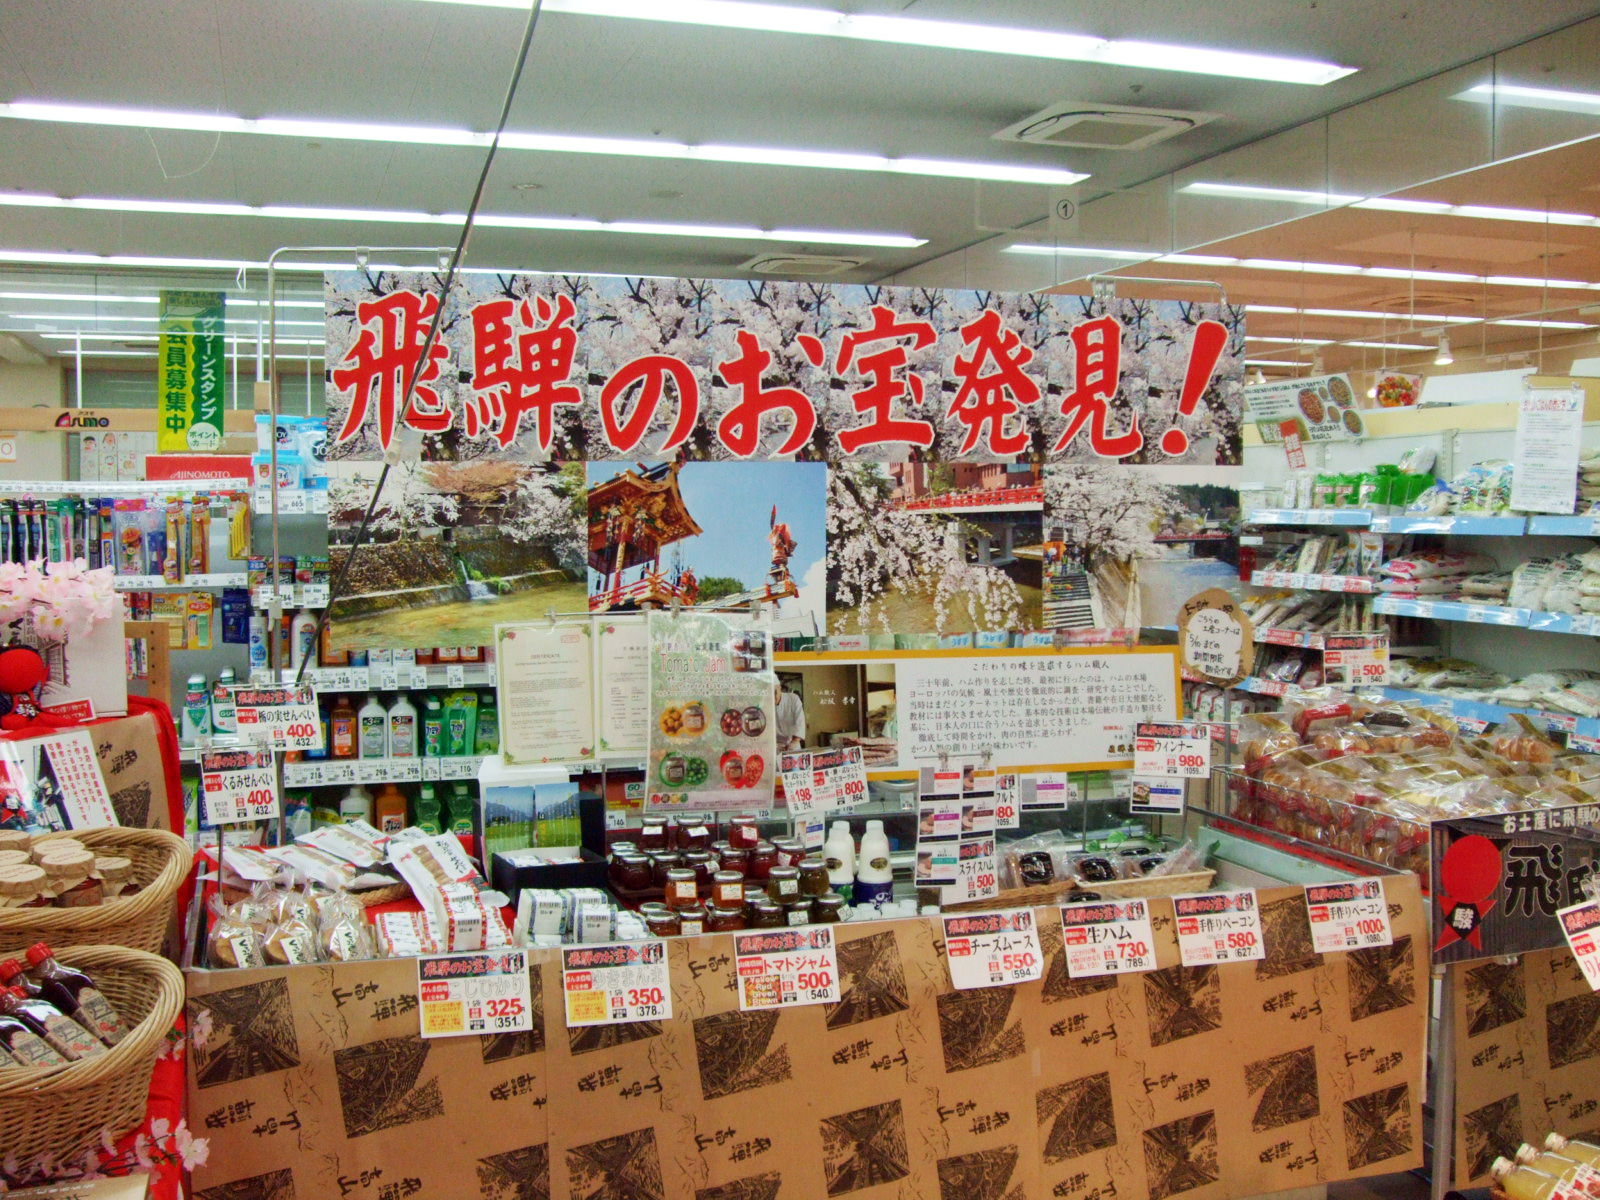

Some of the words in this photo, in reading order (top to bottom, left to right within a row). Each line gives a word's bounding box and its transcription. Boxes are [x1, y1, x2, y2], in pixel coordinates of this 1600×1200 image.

[200, 316, 217, 420] グリーンスタンプ
[166, 324, 188, 434] 会員募集中
[170, 471, 231, 480] AJINOMOTO
[704, 654, 728, 673] Jam
[294, 738, 316, 747] (432)
[1155, 740, 1193, 752] ウィンナー
[222, 773, 273, 790] くるみせんべい
[253, 805, 274, 816] (432)
[996, 806, 1014, 818] 80
[1330, 903, 1382, 920] 手作りベーコン
[1200, 915, 1256, 933] 手作りベーコン
[1088, 925, 1132, 944] 生ハム
[1364, 933, 1386, 944] (1080)
[971, 935, 1033, 955] チーズムース
[1235, 947, 1259, 957] (627)
[763, 955, 831, 974] トマトジャム
[1125, 956, 1150, 968] (789)
[1011, 967, 1038, 979] (594)
[806, 988, 833, 1000] (540)
[636, 1005, 665, 1016] (378)
[494, 1016, 524, 1028] (351)
